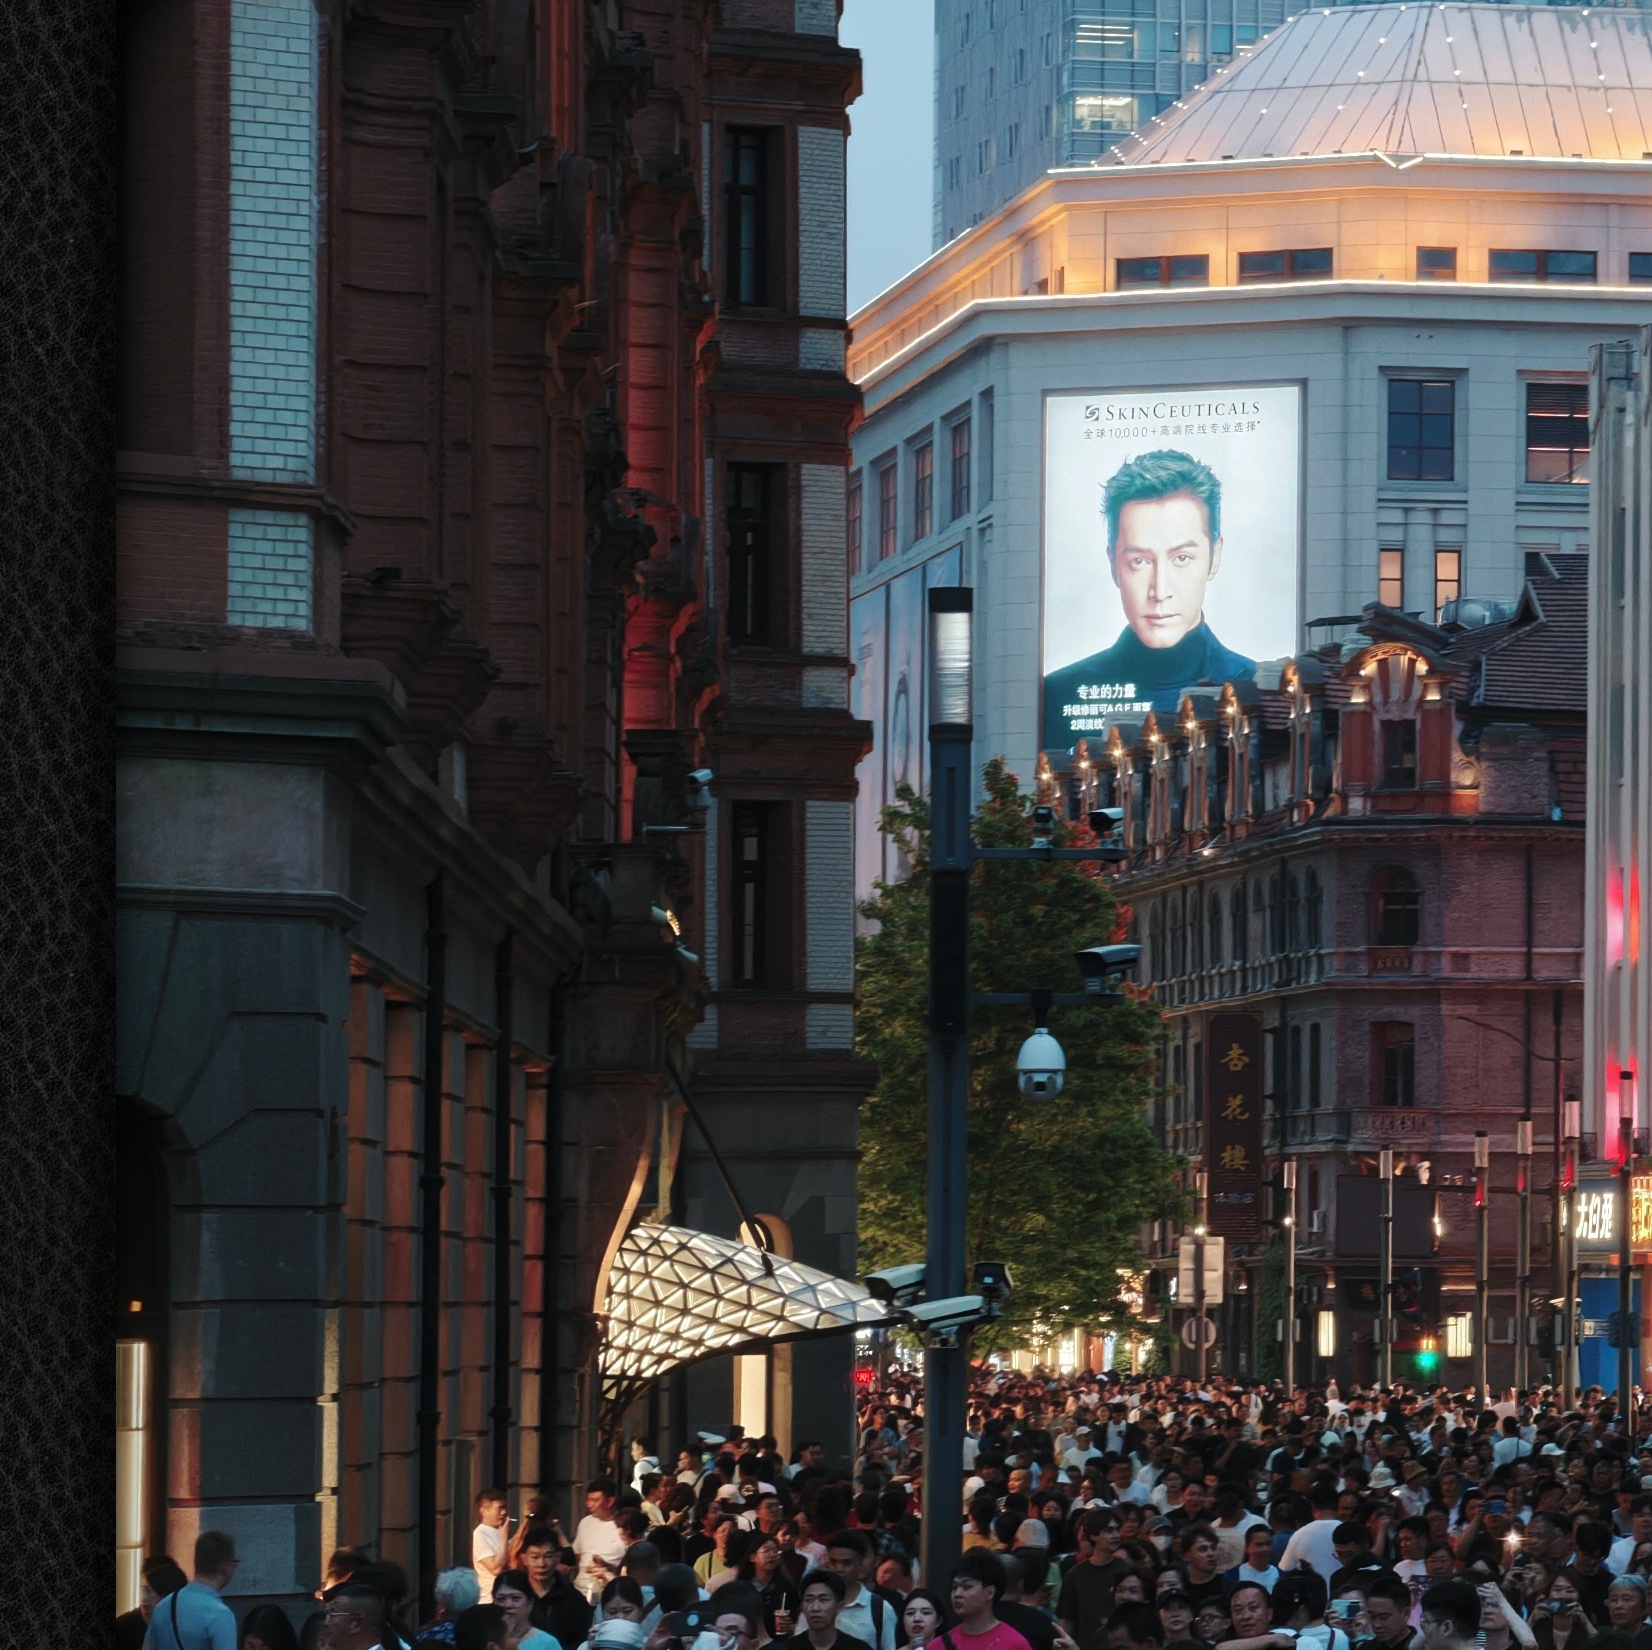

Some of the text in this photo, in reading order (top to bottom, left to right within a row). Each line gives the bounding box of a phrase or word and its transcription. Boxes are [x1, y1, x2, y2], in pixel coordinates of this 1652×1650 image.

[1076, 683, 1136, 700] 专业的力量
[1575, 1191, 1614, 1239] 大白兔
